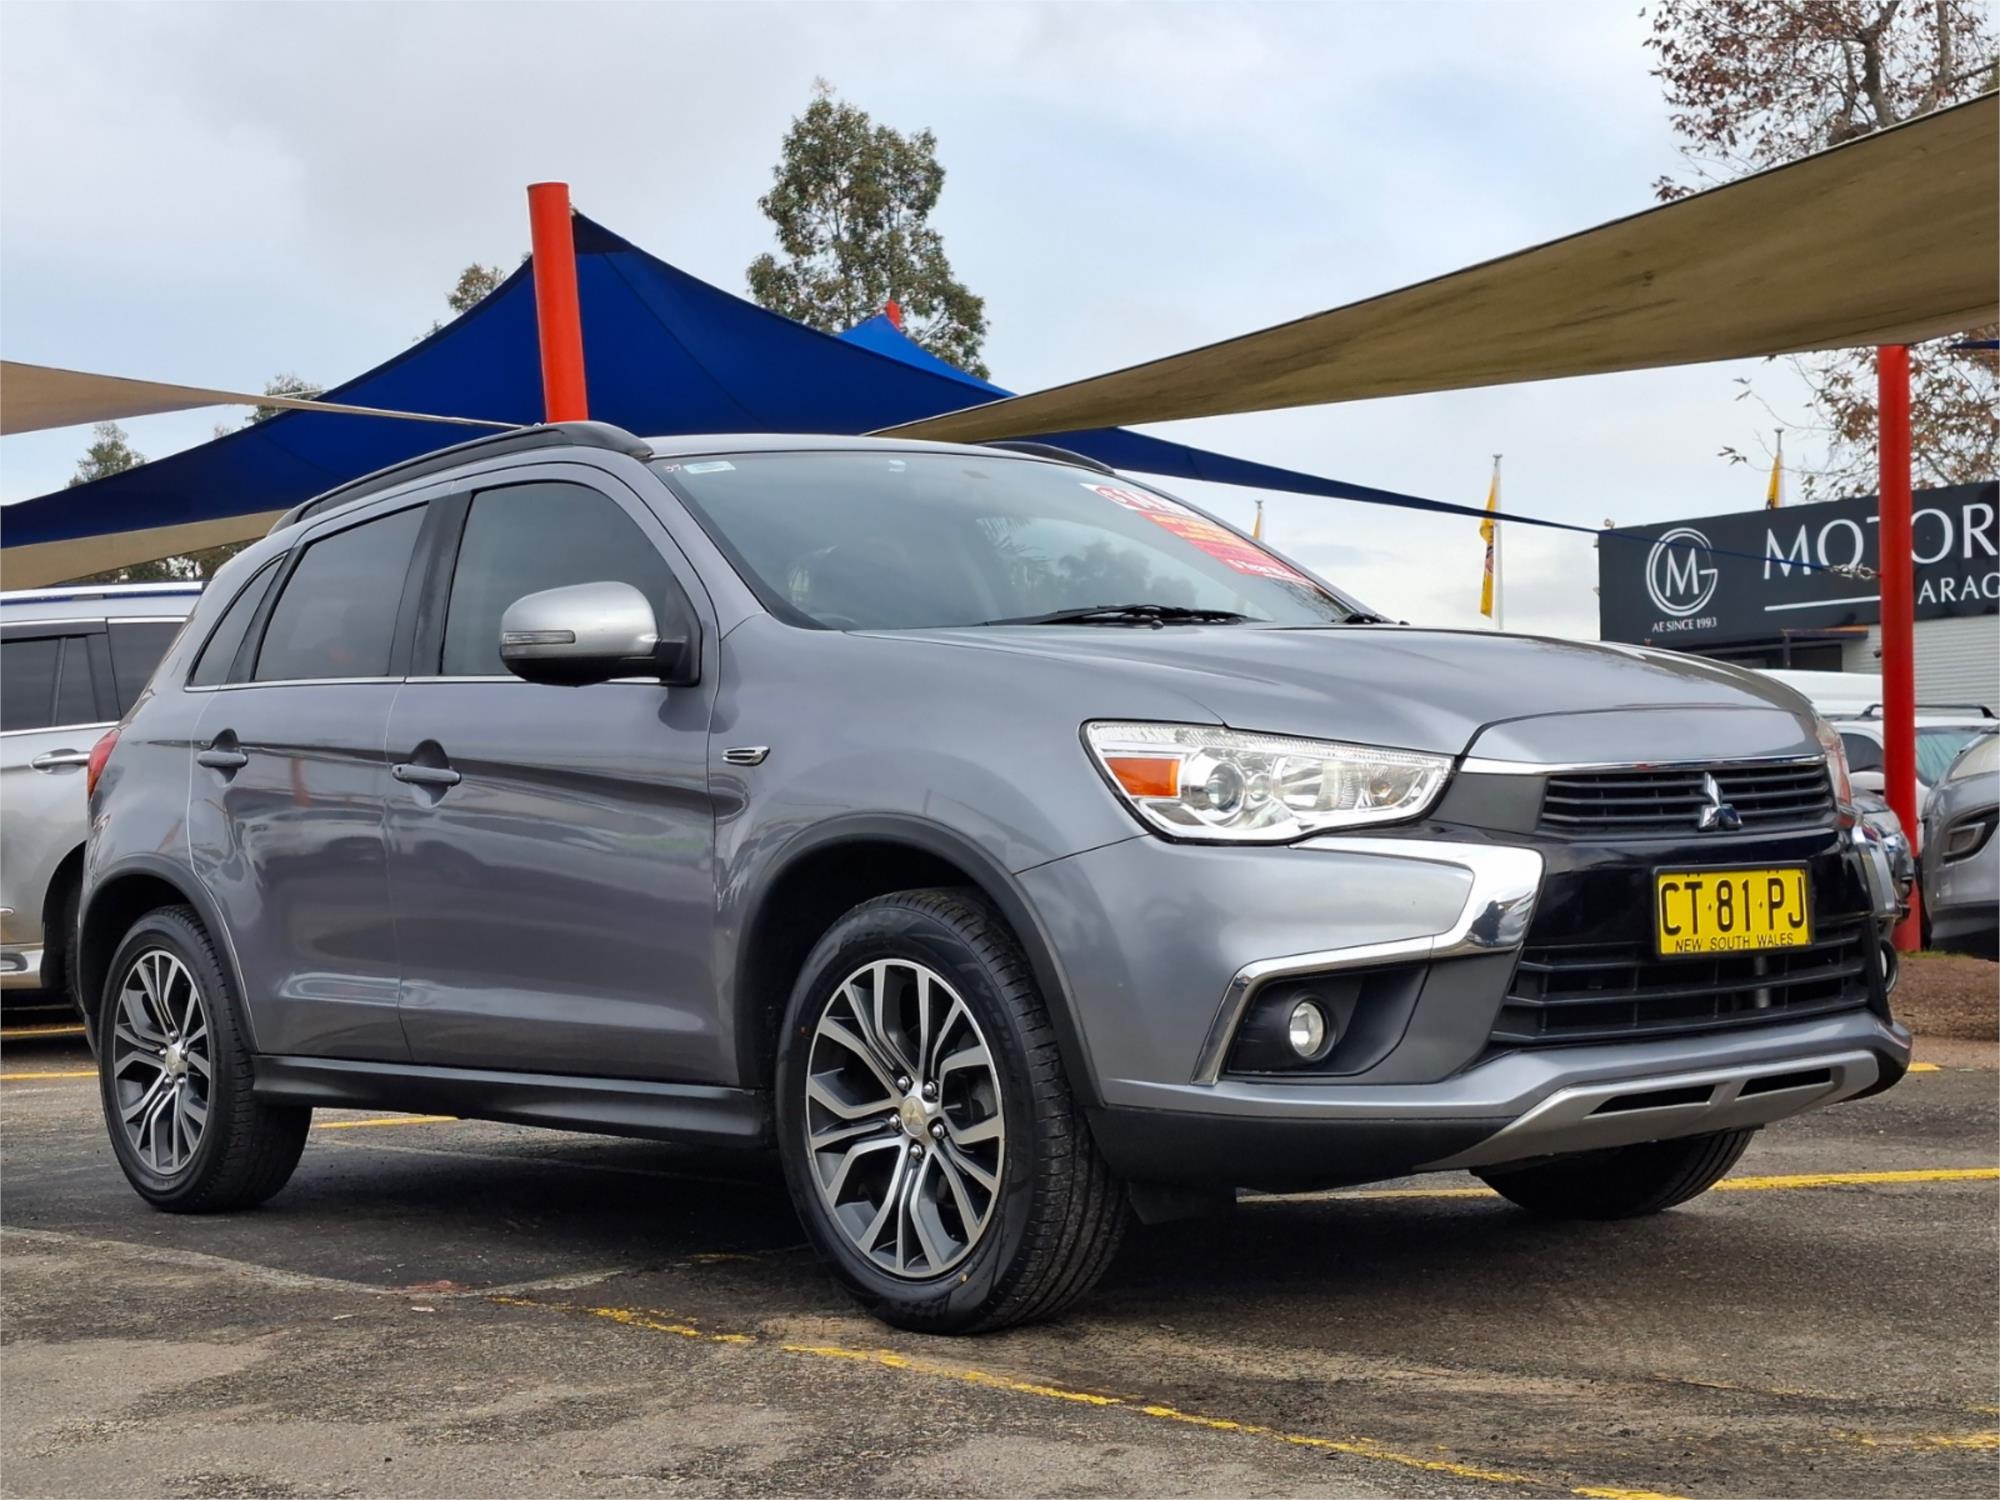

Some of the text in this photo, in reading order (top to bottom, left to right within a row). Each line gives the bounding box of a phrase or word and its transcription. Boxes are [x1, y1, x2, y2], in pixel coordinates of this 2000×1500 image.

[1763, 503, 1999, 580] MOOR
[1917, 572, 2000, 605] ARAG
[1666, 618, 1694, 632] SINCE
[1696, 616, 1718, 629] 1993
[1675, 932, 1794, 952] NEW SOUTH WALES
